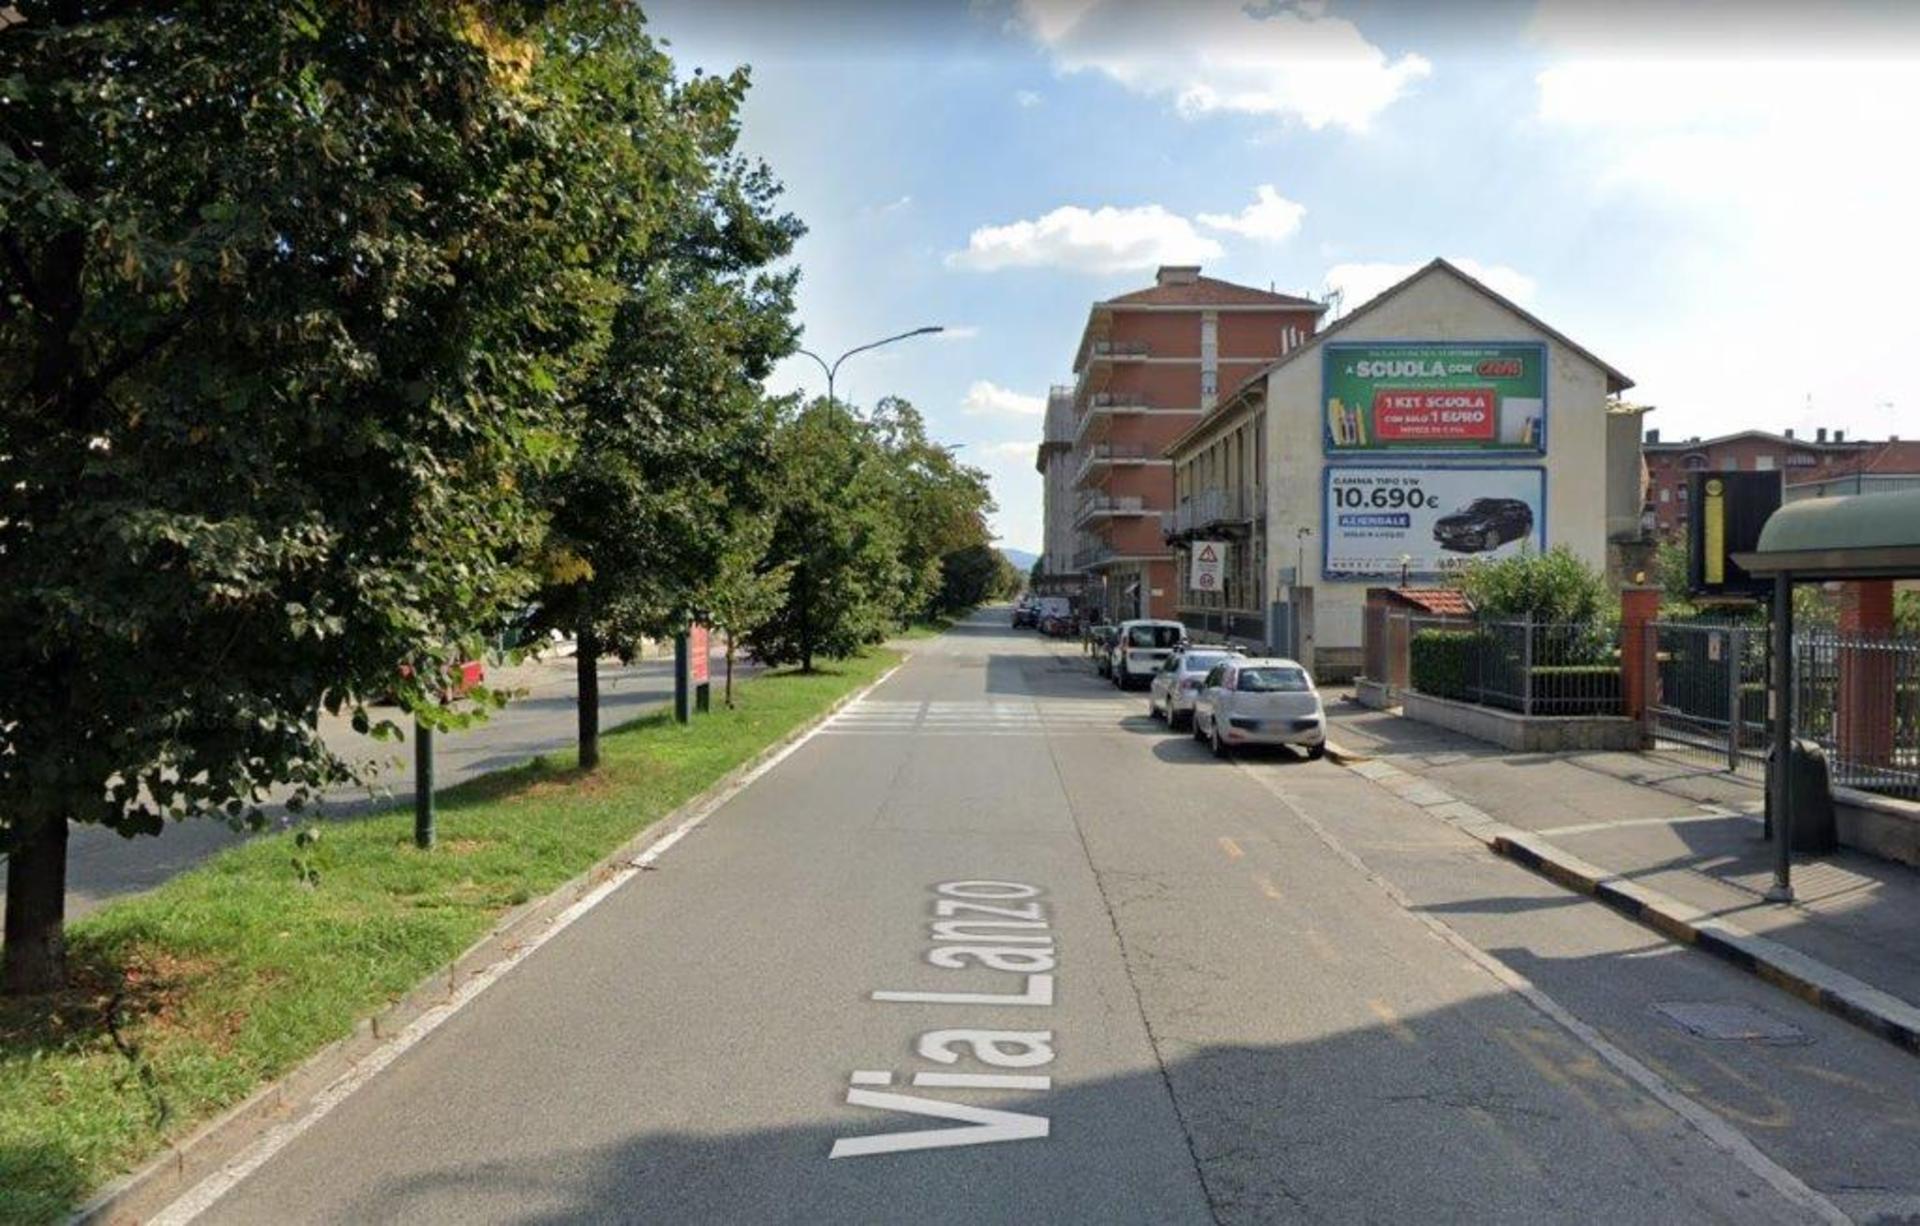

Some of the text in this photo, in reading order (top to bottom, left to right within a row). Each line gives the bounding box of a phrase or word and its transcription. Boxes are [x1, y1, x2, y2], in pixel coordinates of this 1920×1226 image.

[1356, 359, 1447, 378] SCUOLA
[1384, 396, 1485, 408] 1 KIT SCUOLA
[1430, 411, 1438, 423] 1
[1440, 410, 1485, 423] EURO
[1333, 477, 1373, 485] GAMMA
[1376, 477, 1399, 485] TIPO
[1333, 487, 1439, 509] 10.690€
[1342, 516, 1407, 526] AZIENDALE
